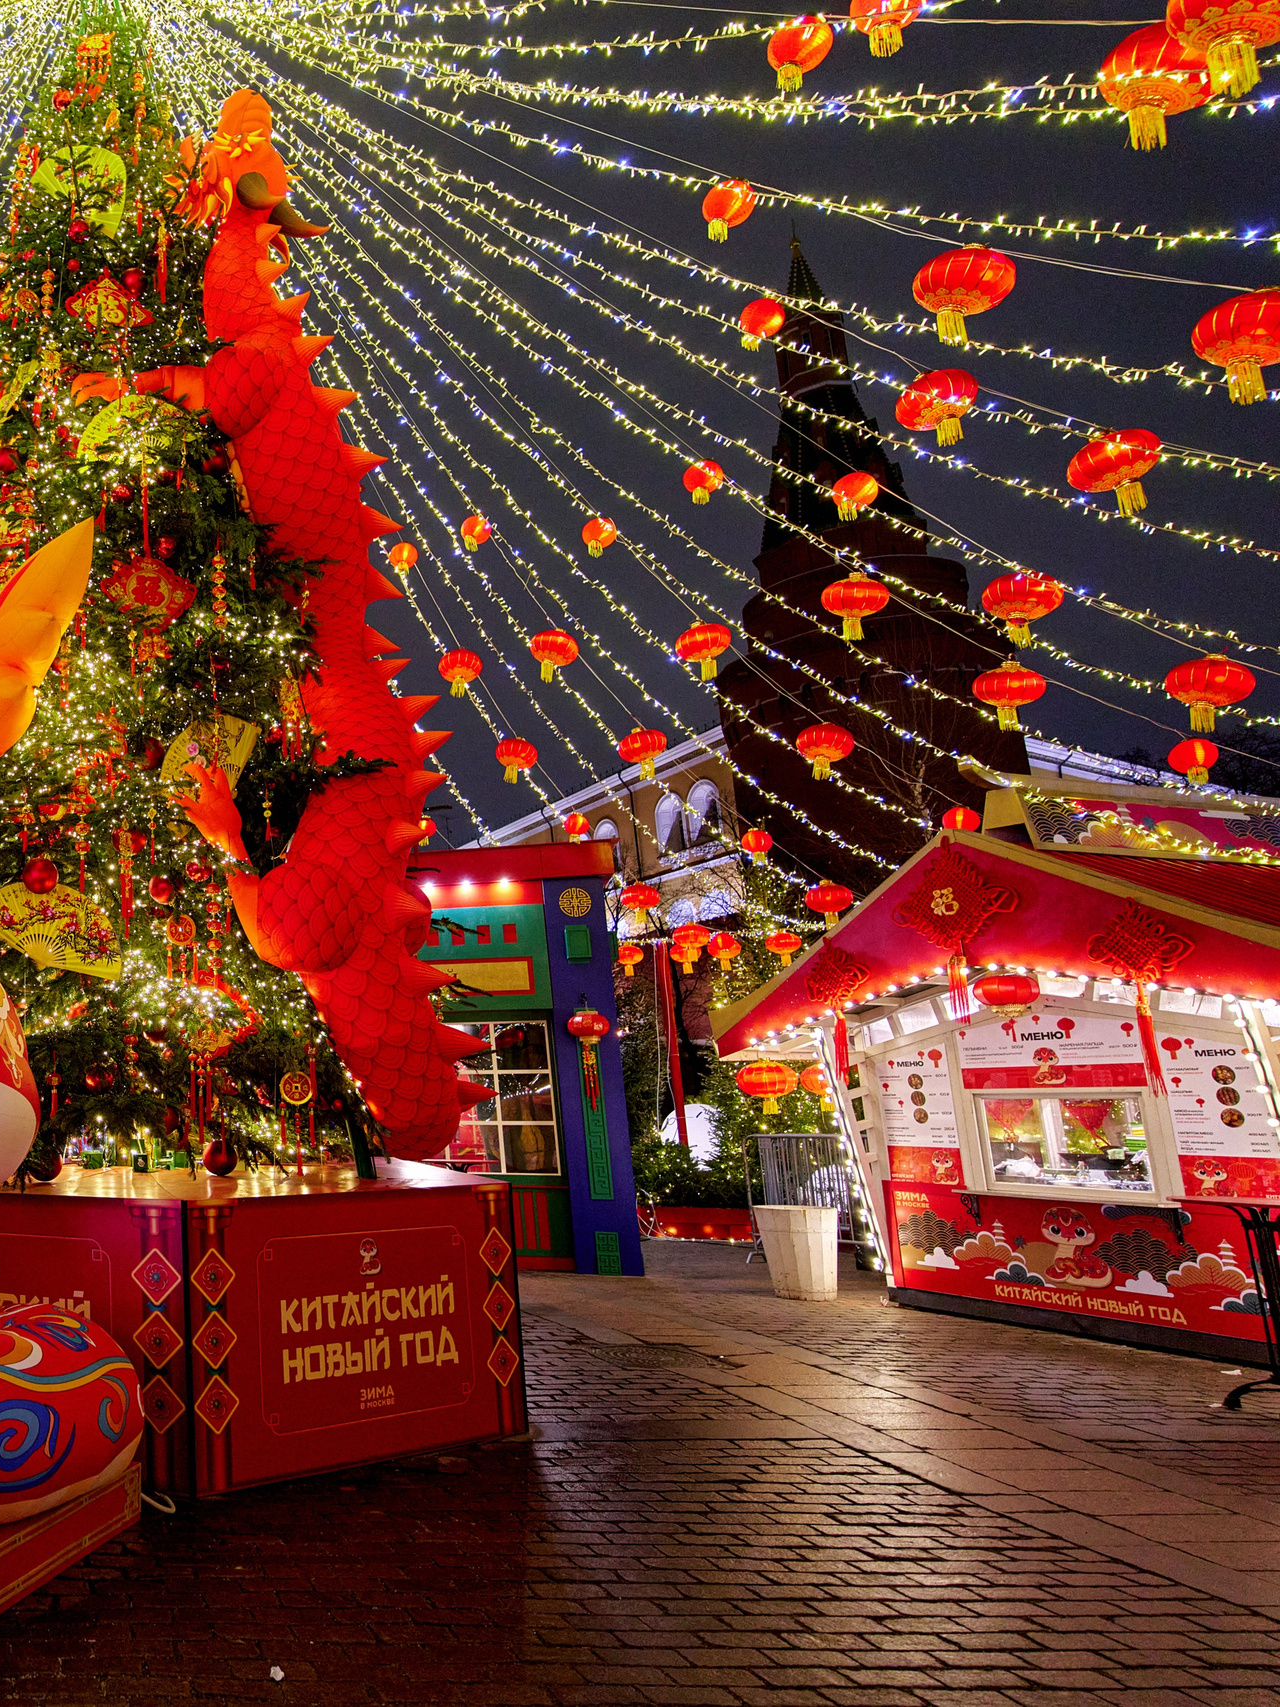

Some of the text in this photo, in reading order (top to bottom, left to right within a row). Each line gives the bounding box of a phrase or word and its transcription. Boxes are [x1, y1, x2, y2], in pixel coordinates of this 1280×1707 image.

[131, 575, 165, 607] 福
[1020, 1030, 1064, 1042] МЕНЮ
[1194, 1048, 1236, 1058] МЕНЮ
[896, 1060, 924, 1068] МЕНЮ
[895, 1191, 929, 1203] ЗИМА
[280, 1275, 455, 1334] КИТАЙСКИЙ
[995, 1284, 1187, 1325] КИТАЙСКИЙ НОВЫЙ ГОД
[282, 1325, 459, 1384] НОВЫЙ ГОД
[360, 1385, 394, 1401] ЗИМА
[366, 1398, 395, 1409] МОСКВЕ
